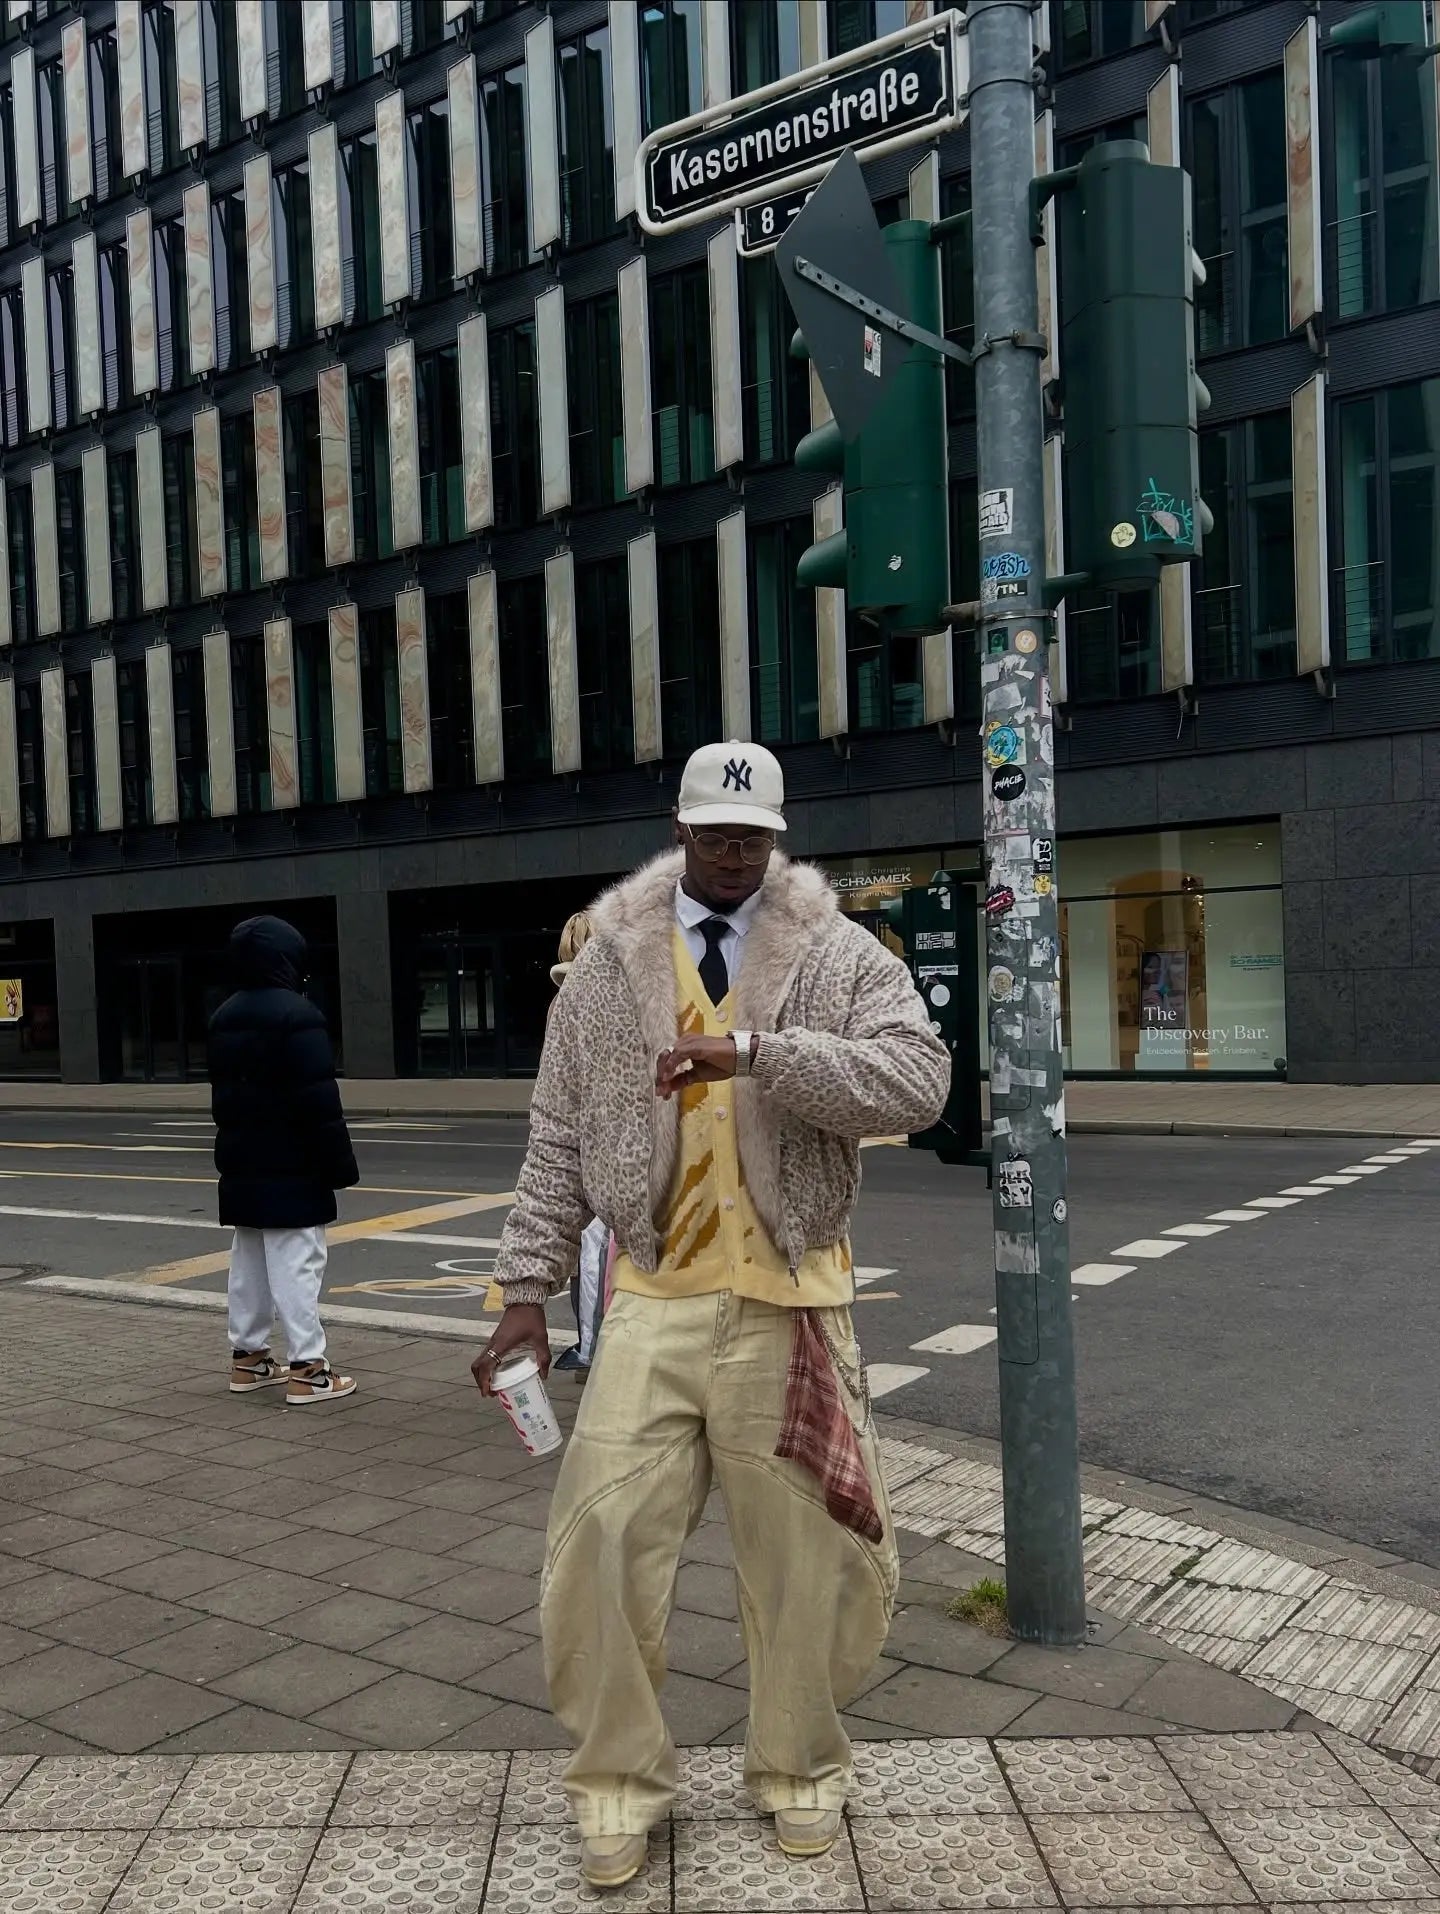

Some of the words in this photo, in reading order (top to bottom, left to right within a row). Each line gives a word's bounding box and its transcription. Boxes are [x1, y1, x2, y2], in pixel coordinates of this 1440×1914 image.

[669, 67, 919, 195] Kasernenstraße
[761, 206, 774, 234] 8
[722, 758, 752, 791] NY
[830, 872, 912, 888] SCHRAMMEK
[1143, 1006, 1177, 1021] The
[1146, 1026, 1229, 1043] Discovery
[1234, 1025, 1269, 1040] Bar.
